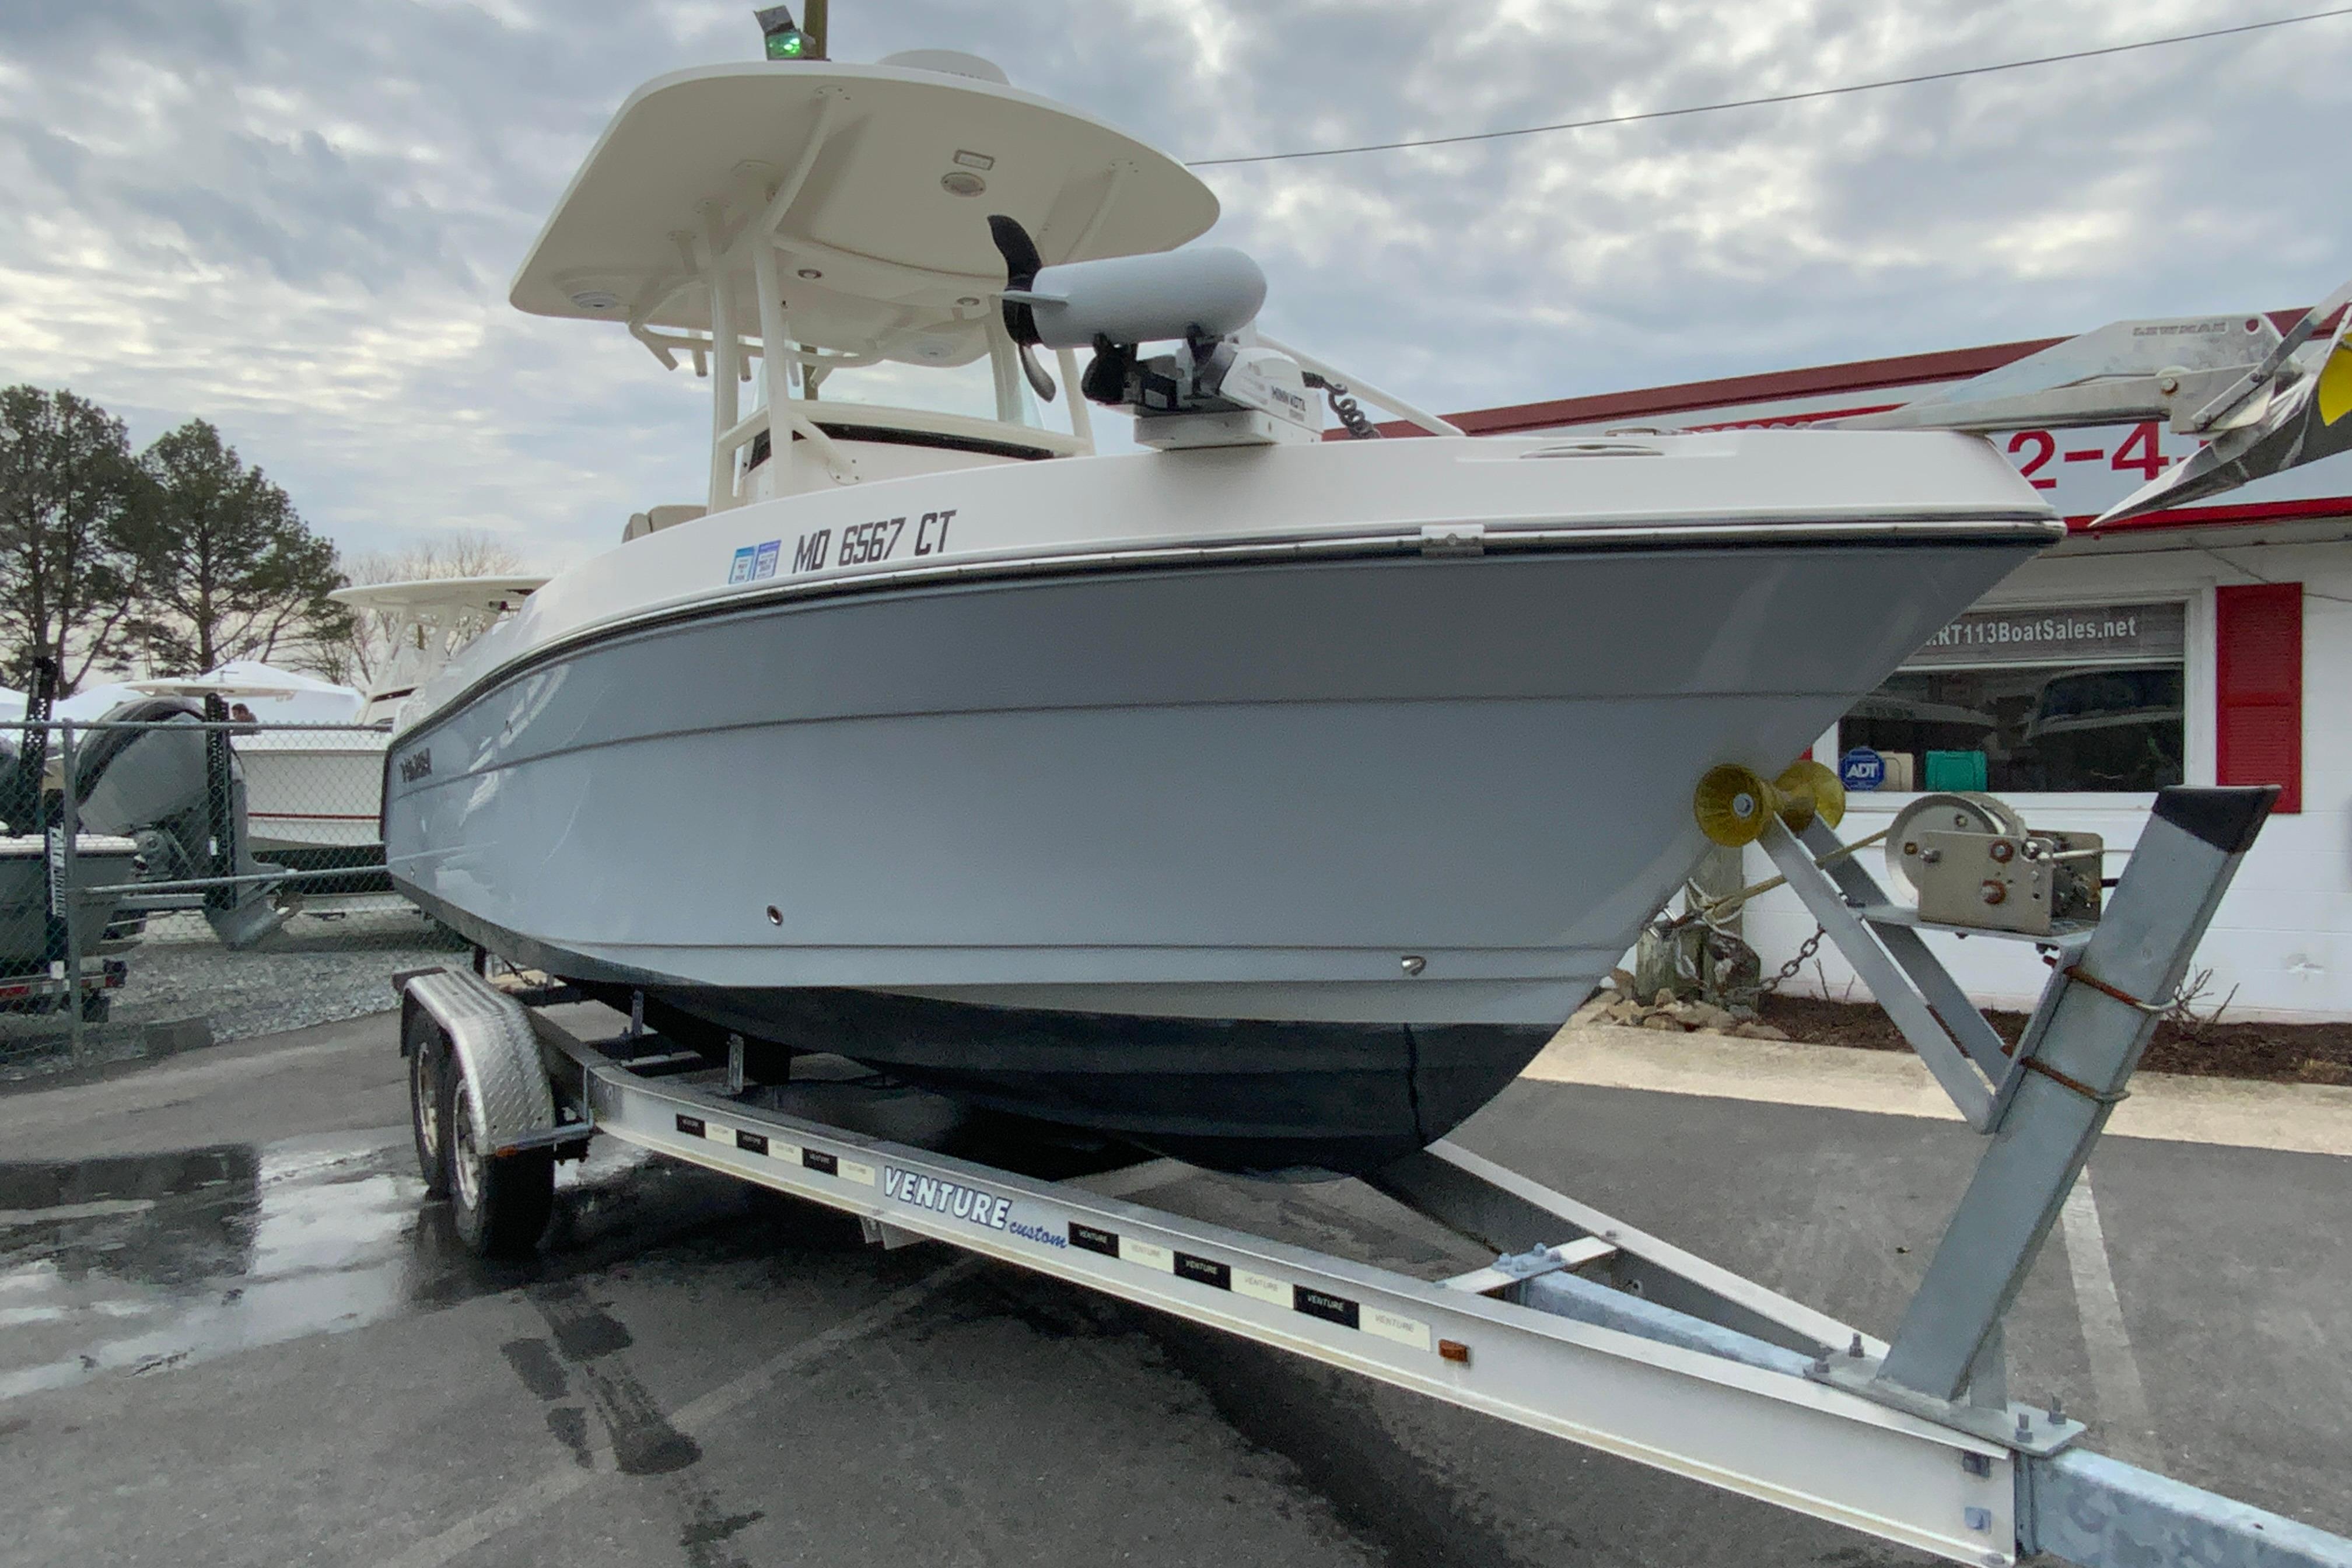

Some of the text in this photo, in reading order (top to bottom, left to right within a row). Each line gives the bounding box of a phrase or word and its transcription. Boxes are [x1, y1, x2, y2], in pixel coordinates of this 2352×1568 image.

[2133, 322, 2226, 336] LEWMAR
[792, 528, 831, 574] MD
[838, 517, 907, 566] 6567
[914, 509, 957, 556] CT
[1846, 762, 1879, 778] ADT
[884, 1166, 1068, 1249] VENTURE custom
[1185, 1260, 1218, 1275] VENTURE
[1244, 1277, 1279, 1292] VENTURE
[1307, 1294, 1344, 1312] VENTURE
[1374, 1314, 1414, 1333] VENTURE
